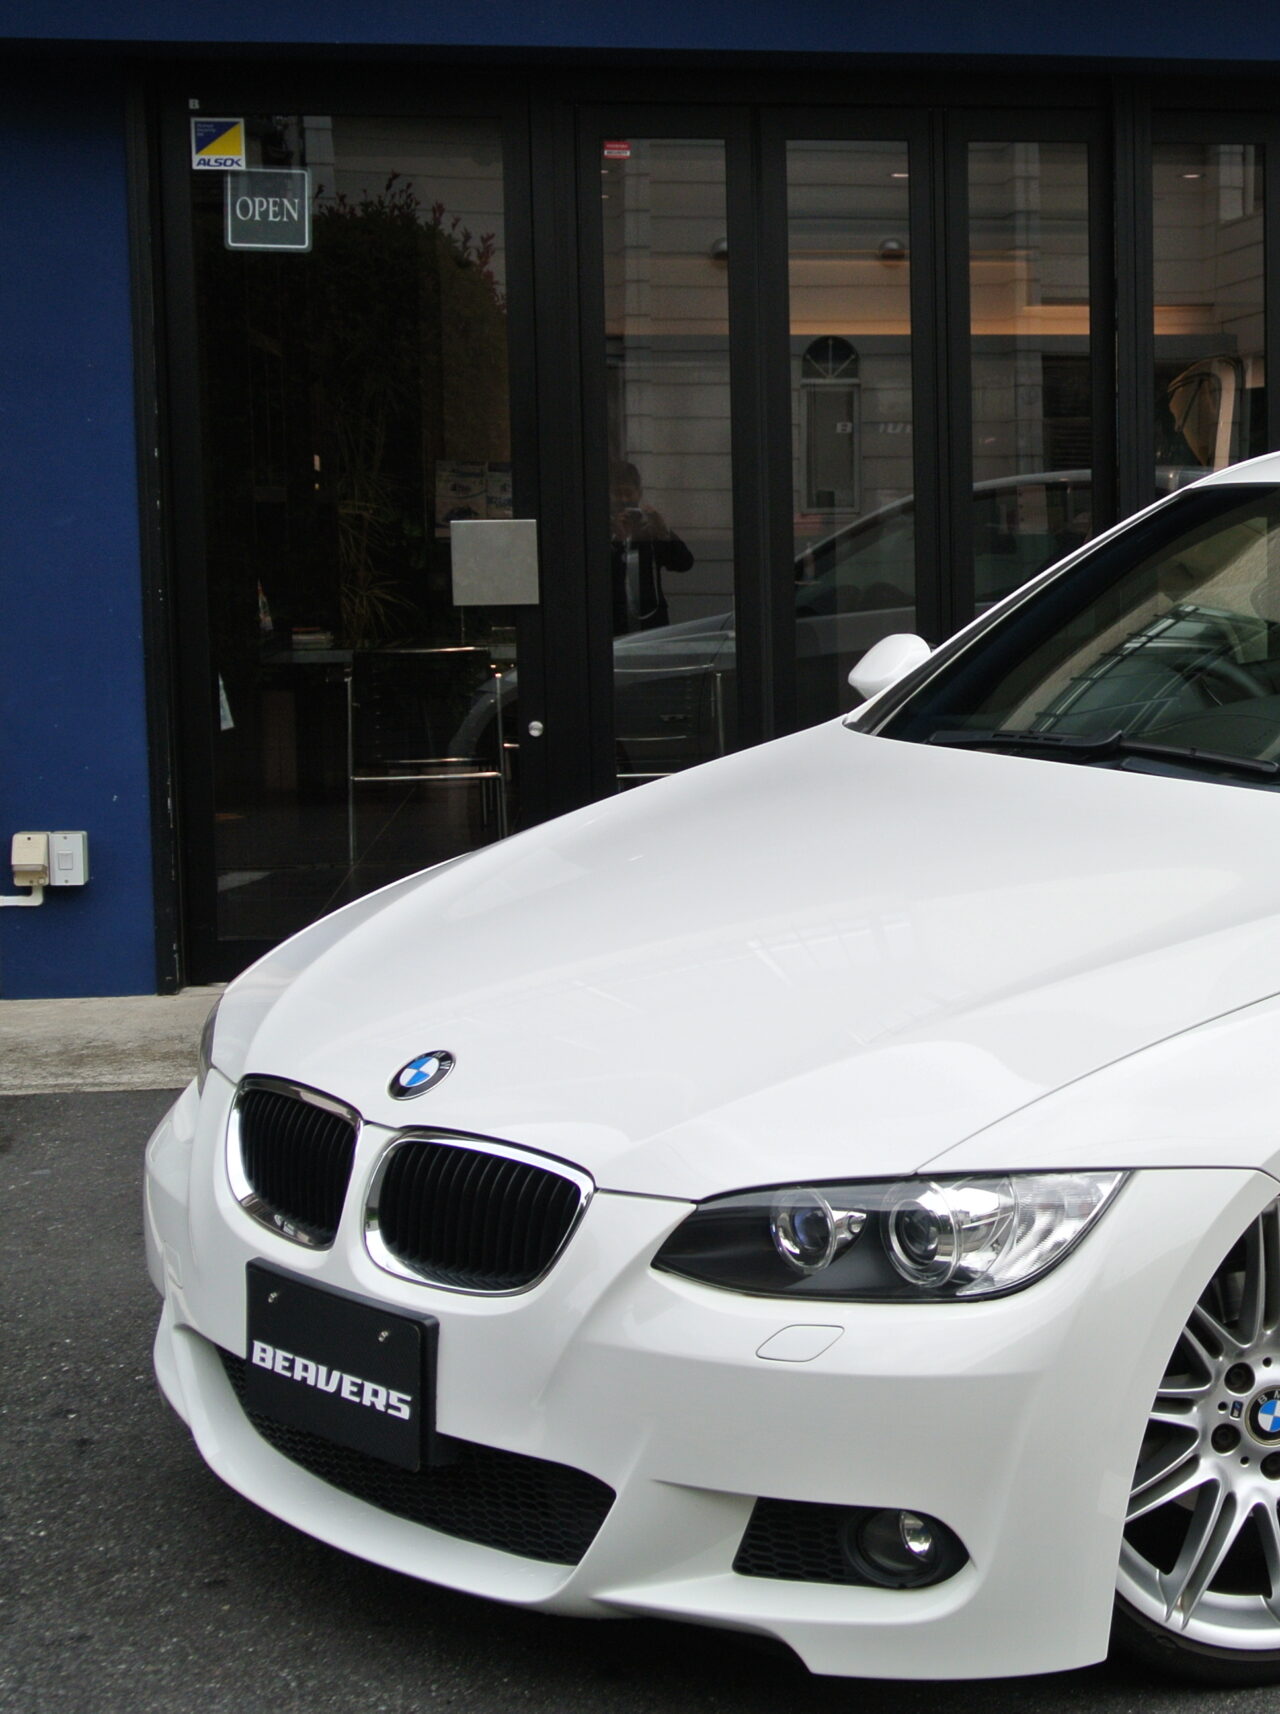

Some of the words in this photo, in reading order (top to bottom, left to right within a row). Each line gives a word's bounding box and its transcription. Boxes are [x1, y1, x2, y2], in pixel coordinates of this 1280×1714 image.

[196, 157, 242, 168] ALSOK
[235, 196, 299, 221] OPEN
[252, 1340, 412, 1420] BEAVERS
